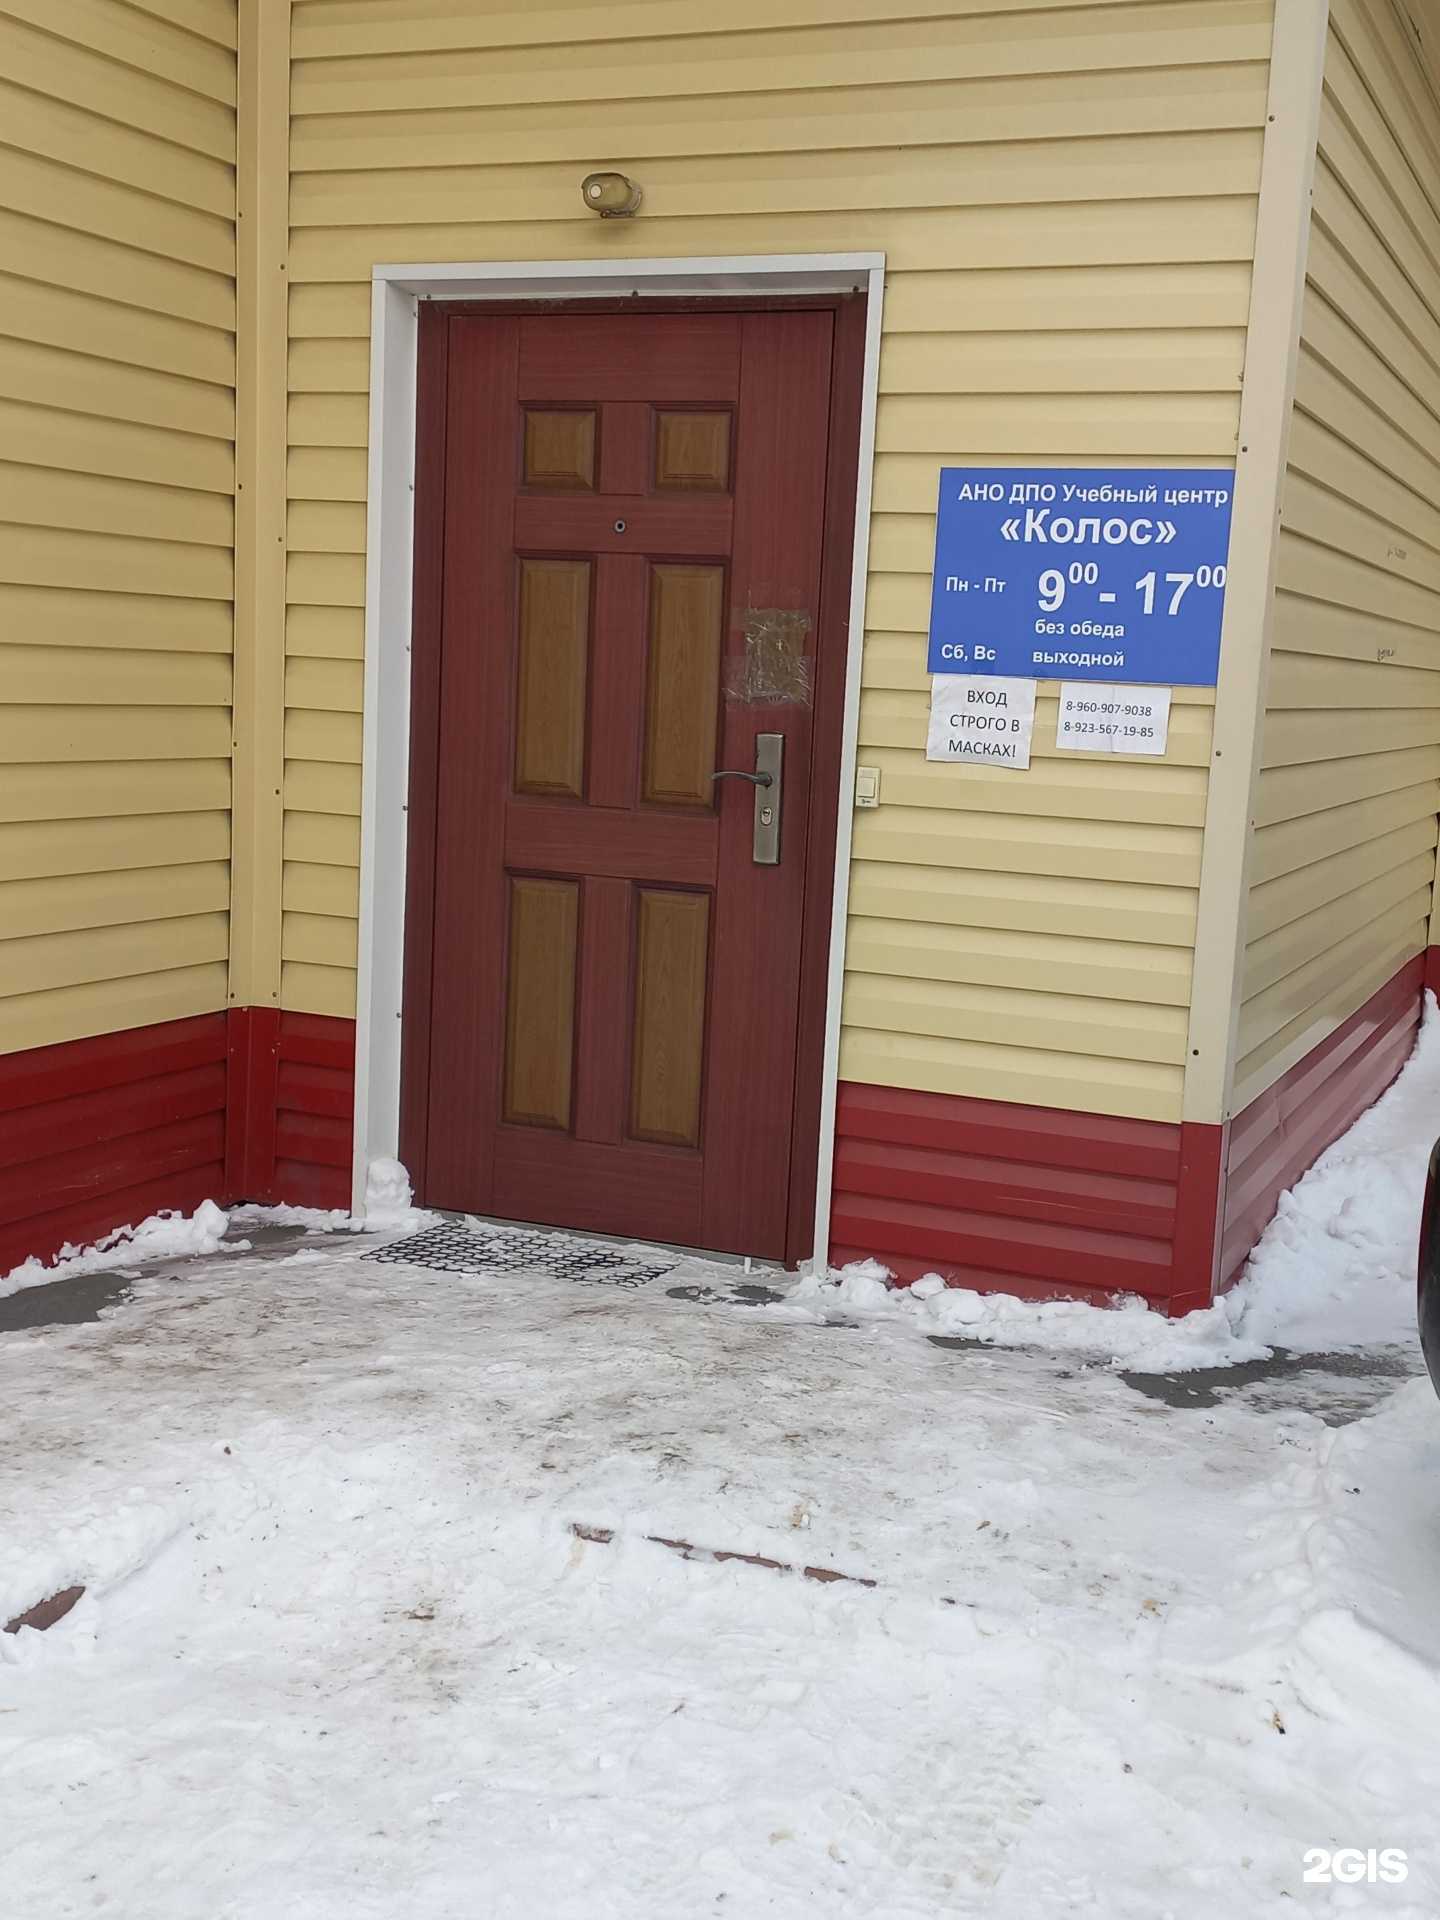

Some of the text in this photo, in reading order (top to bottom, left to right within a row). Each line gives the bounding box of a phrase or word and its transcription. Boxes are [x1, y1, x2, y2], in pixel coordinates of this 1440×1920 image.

[958, 483, 1229, 508] АНО ДПО Учебный центр
[1000, 508, 1177, 545] «Колос»
[946, 576, 969, 592] Пн
[984, 577, 1006, 593] Пт
[1035, 619, 1125, 638] без обеда
[941, 643, 996, 662] Сб, Вс
[1032, 650, 1125, 667] выходной
[967, 690, 1008, 708] ВХОД
[1065, 700, 1152, 717] 8-960-907-9038
[950, 714, 1020, 733] СТРОГО В
[1064, 721, 1154, 738] 8-923-567-19-85
[949, 739, 1017, 758] МАСКАХ!
